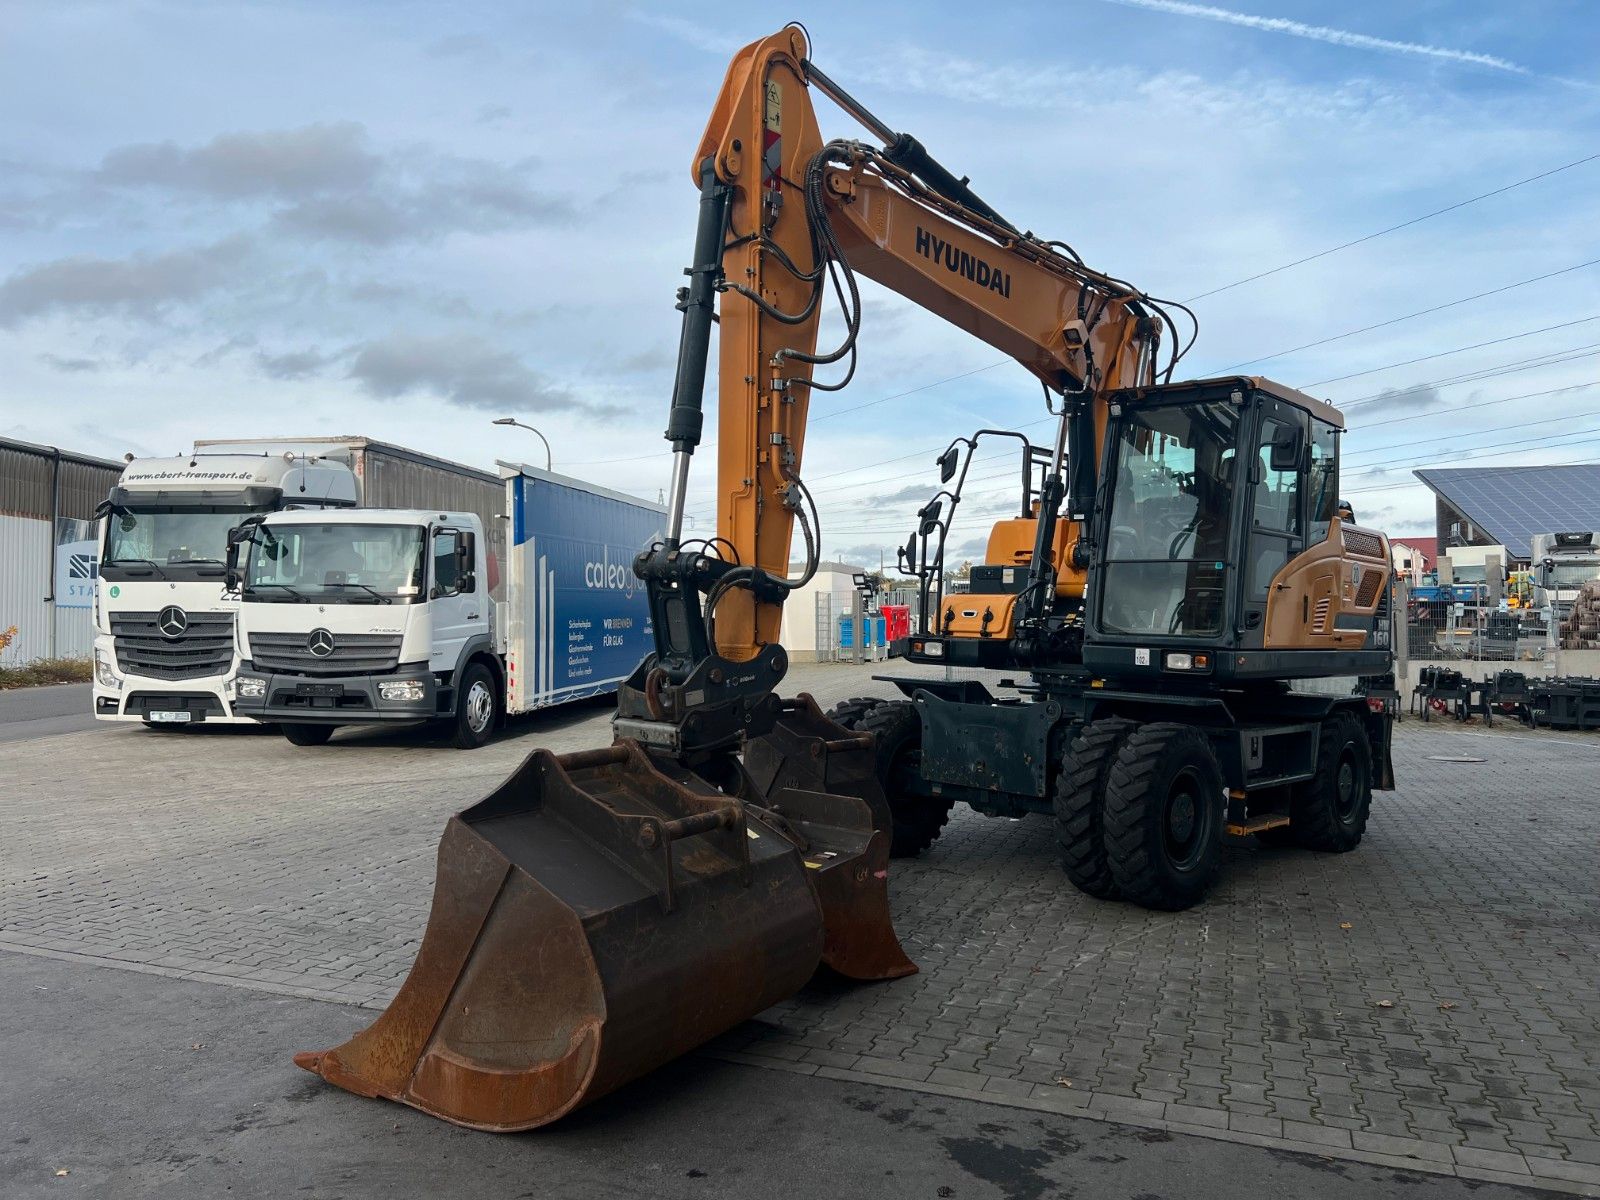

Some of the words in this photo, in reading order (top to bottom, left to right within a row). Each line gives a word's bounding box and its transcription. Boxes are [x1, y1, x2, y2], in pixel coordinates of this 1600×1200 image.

[915, 226, 1011, 299] HYUNDAI
[128, 471, 253, 480] www.ebert-transport.de
[603, 634, 612, 647] FÜR
[612, 635, 624, 646] GLAS
[1373, 631, 1389, 646] 160
